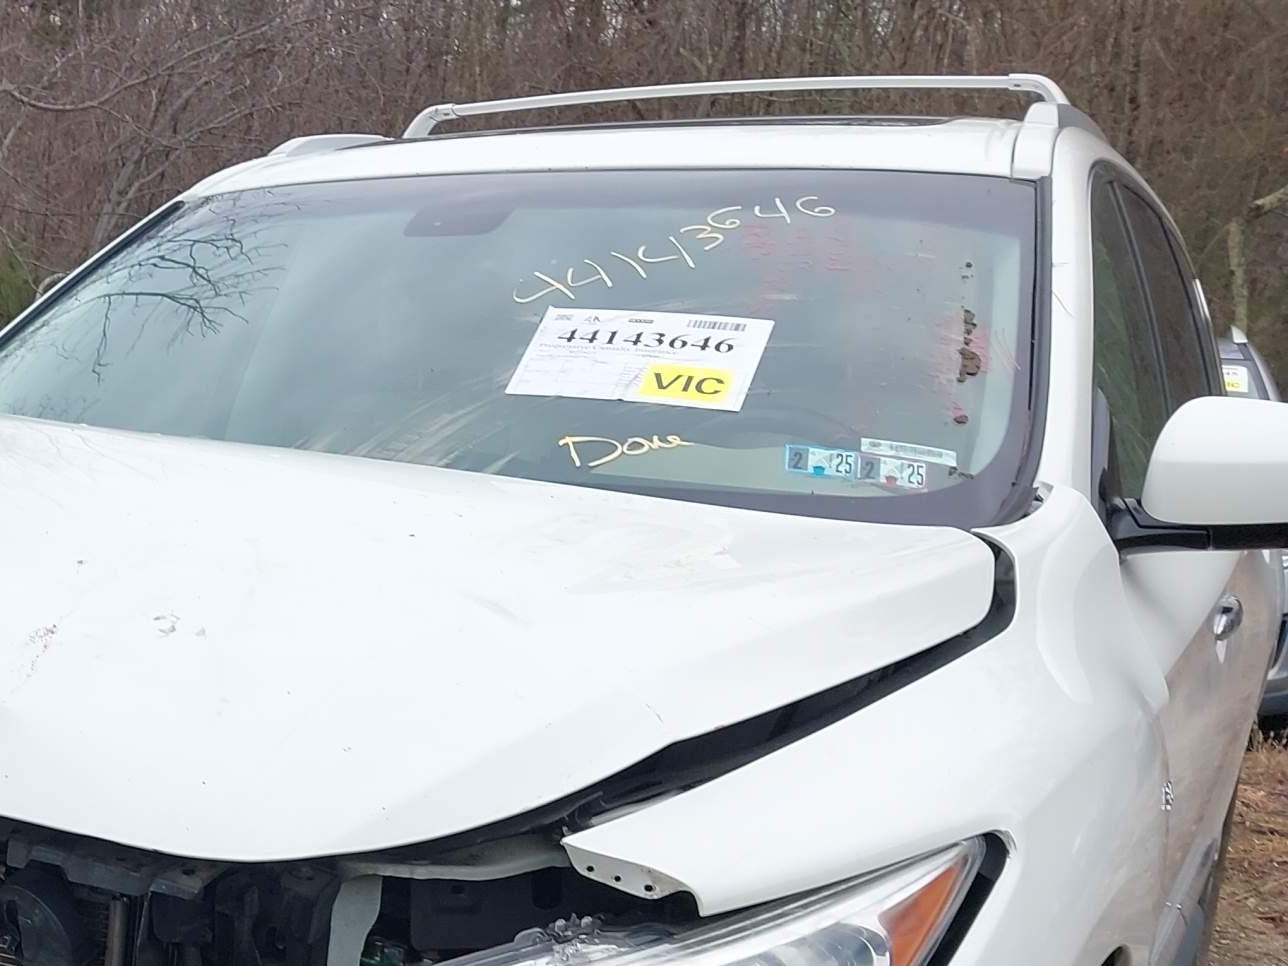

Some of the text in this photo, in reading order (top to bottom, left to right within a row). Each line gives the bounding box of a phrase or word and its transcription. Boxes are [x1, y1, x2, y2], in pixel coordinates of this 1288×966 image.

[557, 328, 736, 353] 44143646
[654, 372, 725, 395] VIC
[836, 453, 853, 475] 25
[907, 463, 924, 486] 25
